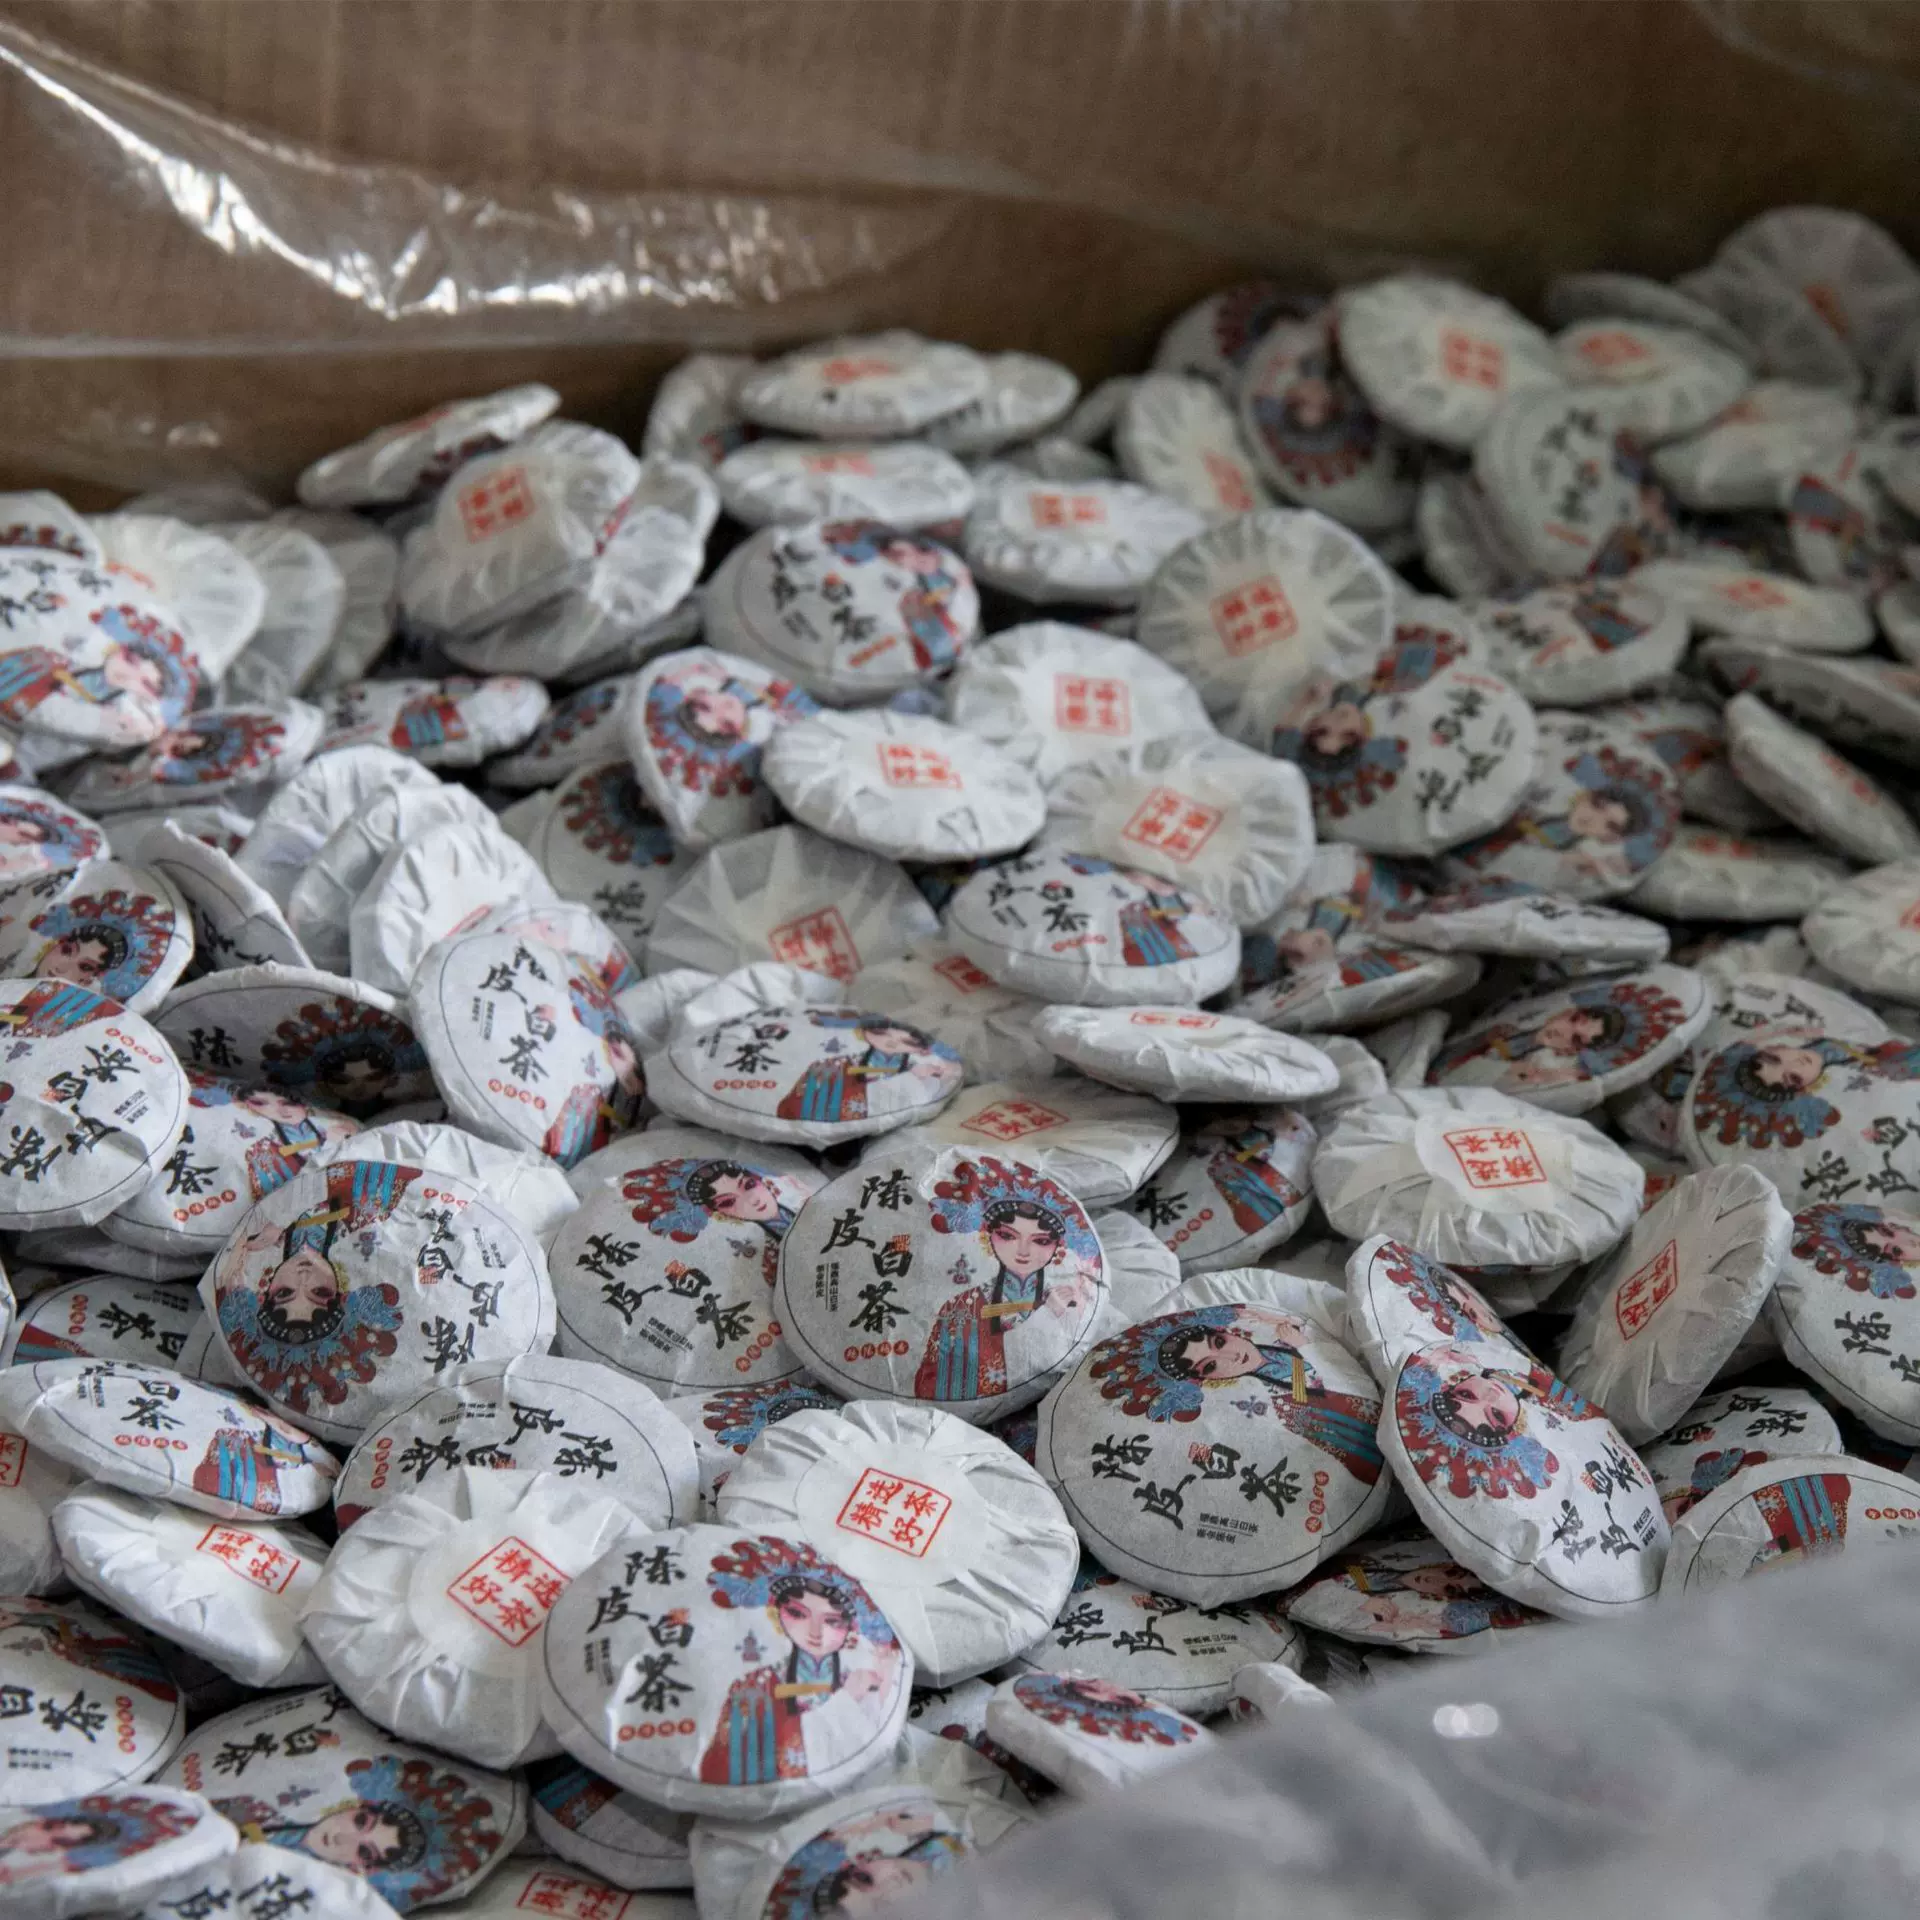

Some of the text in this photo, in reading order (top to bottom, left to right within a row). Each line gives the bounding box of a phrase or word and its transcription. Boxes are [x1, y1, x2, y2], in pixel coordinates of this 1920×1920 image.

[820, 1168, 914, 1335] 陈皮白茶
[1091, 1433, 1304, 1530] 陈皮白茶
[586, 1545, 696, 1714] 陈皮白茶
